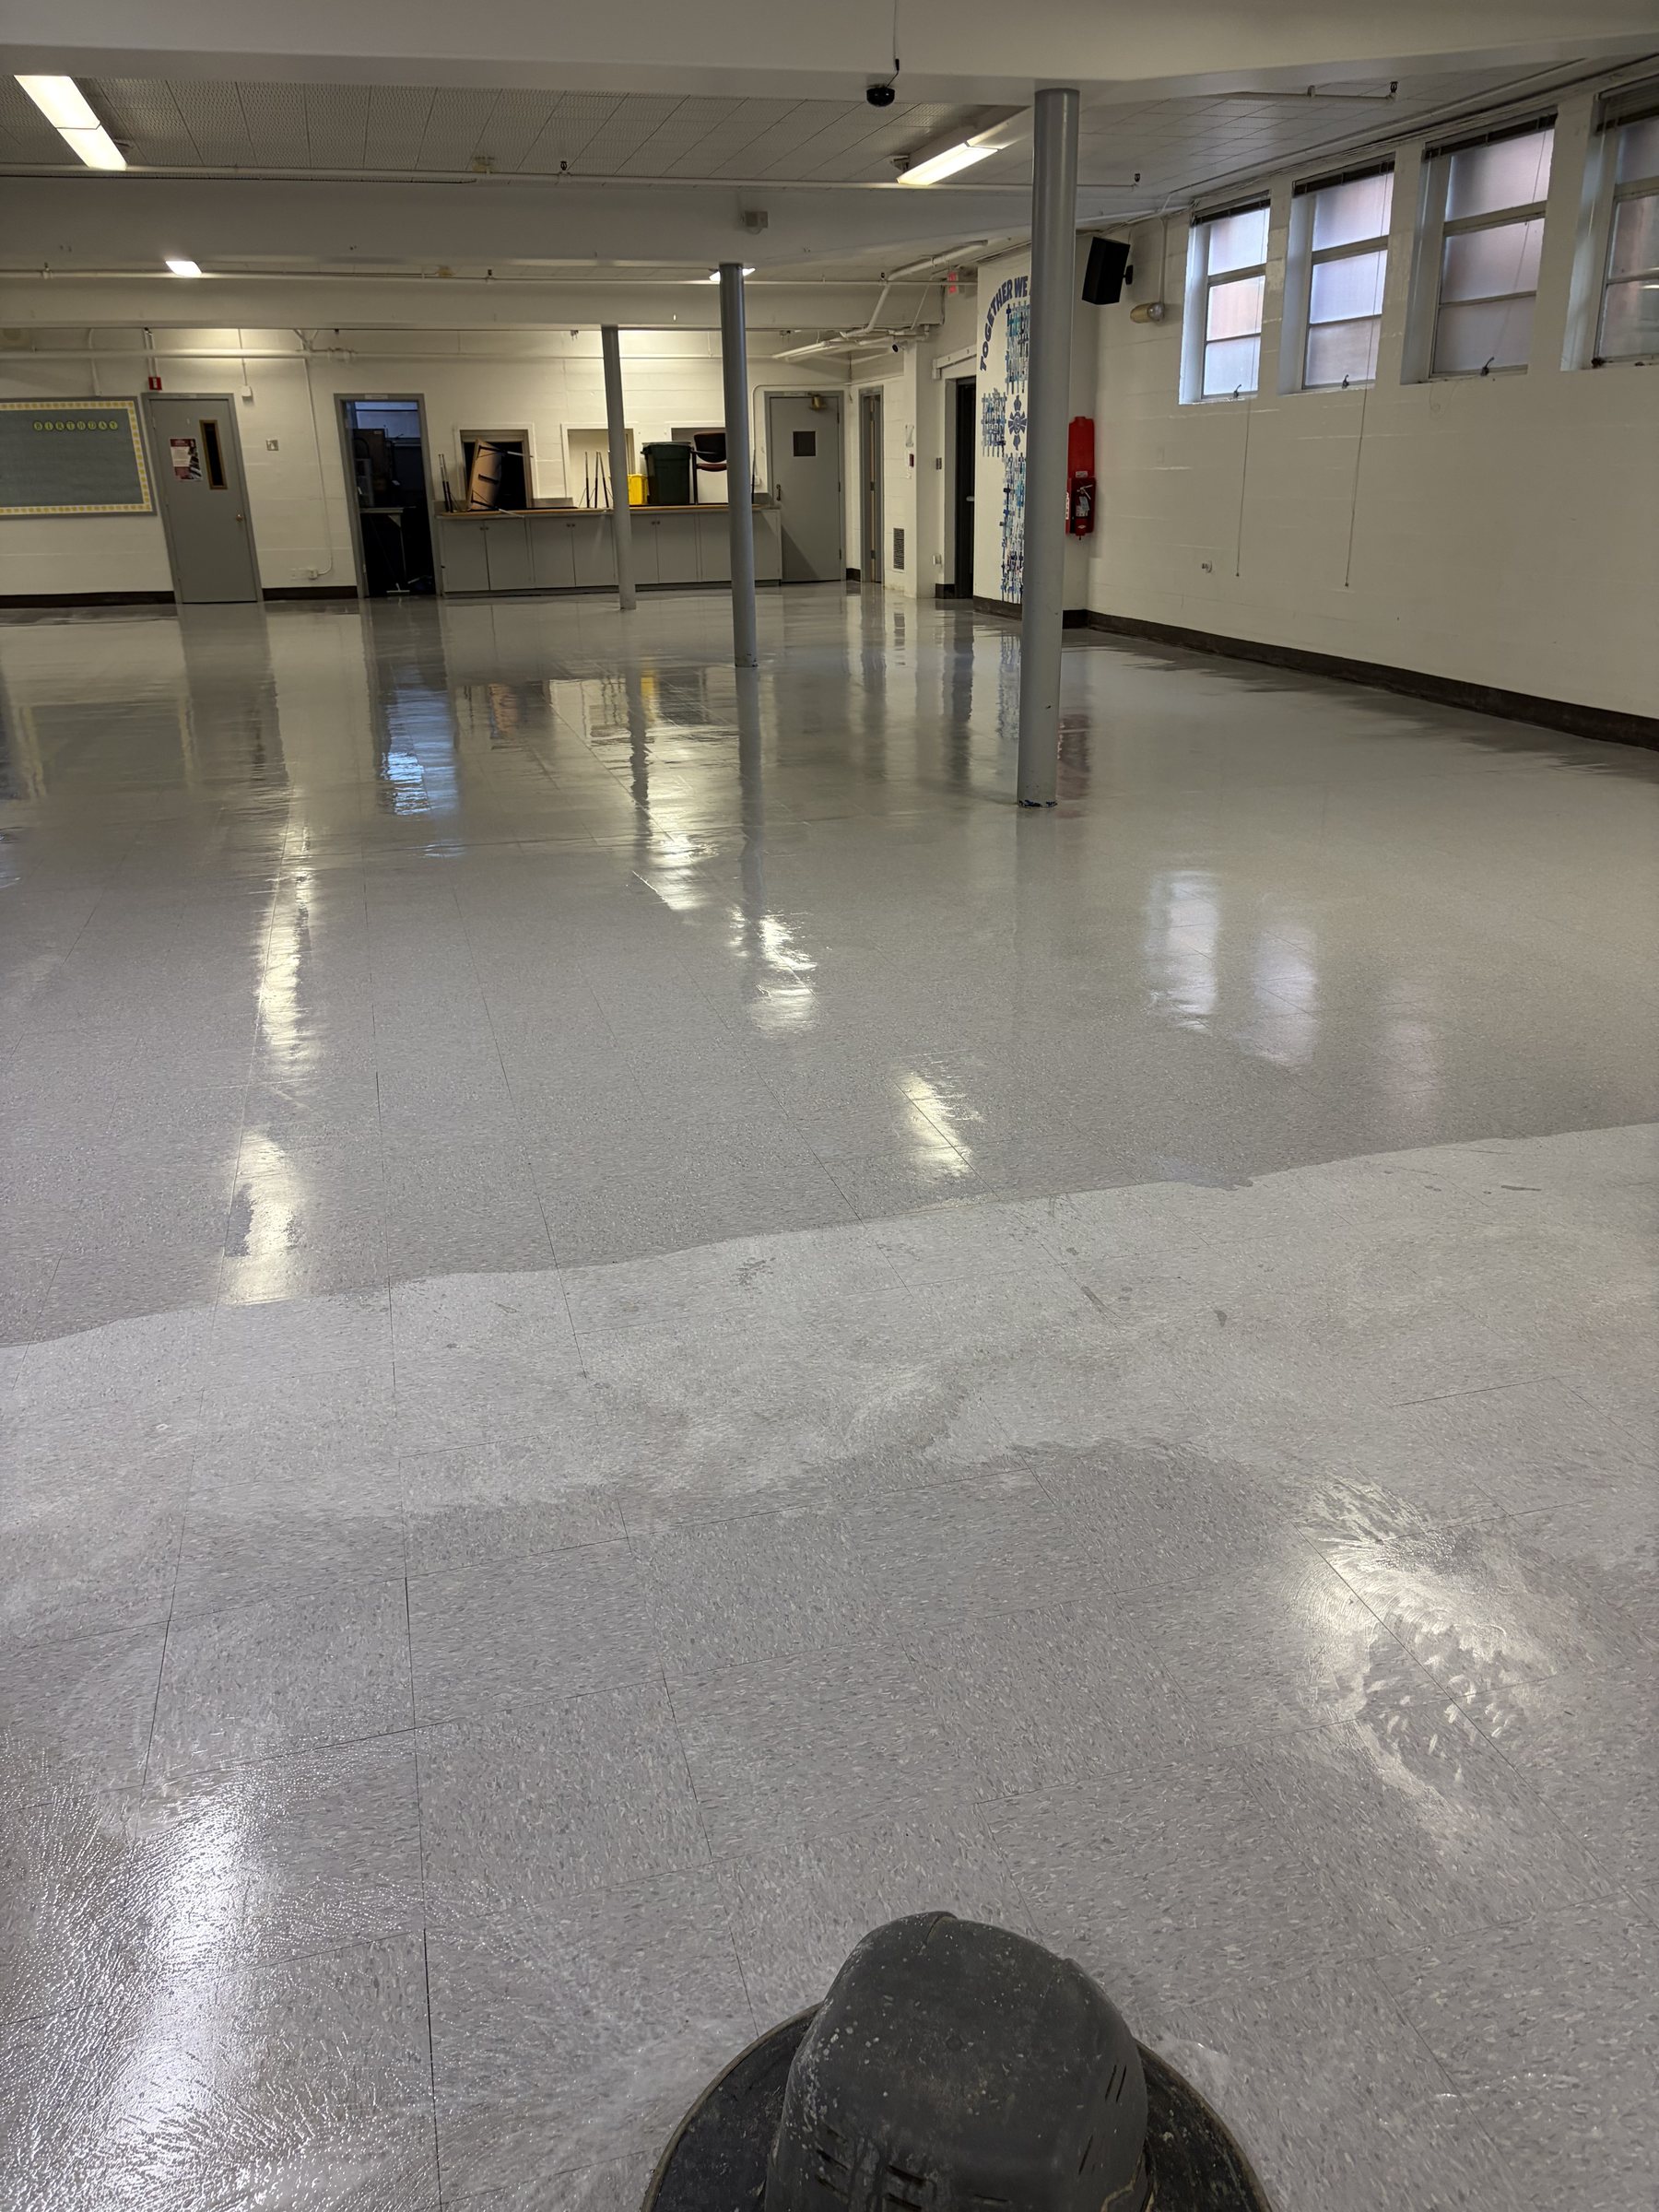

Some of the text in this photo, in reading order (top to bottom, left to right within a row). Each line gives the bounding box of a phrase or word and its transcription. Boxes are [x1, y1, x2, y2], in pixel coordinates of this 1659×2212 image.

[980, 276, 1028, 371] TOGETHER WE
[34, 420, 118, 431] BIRTHDAY
